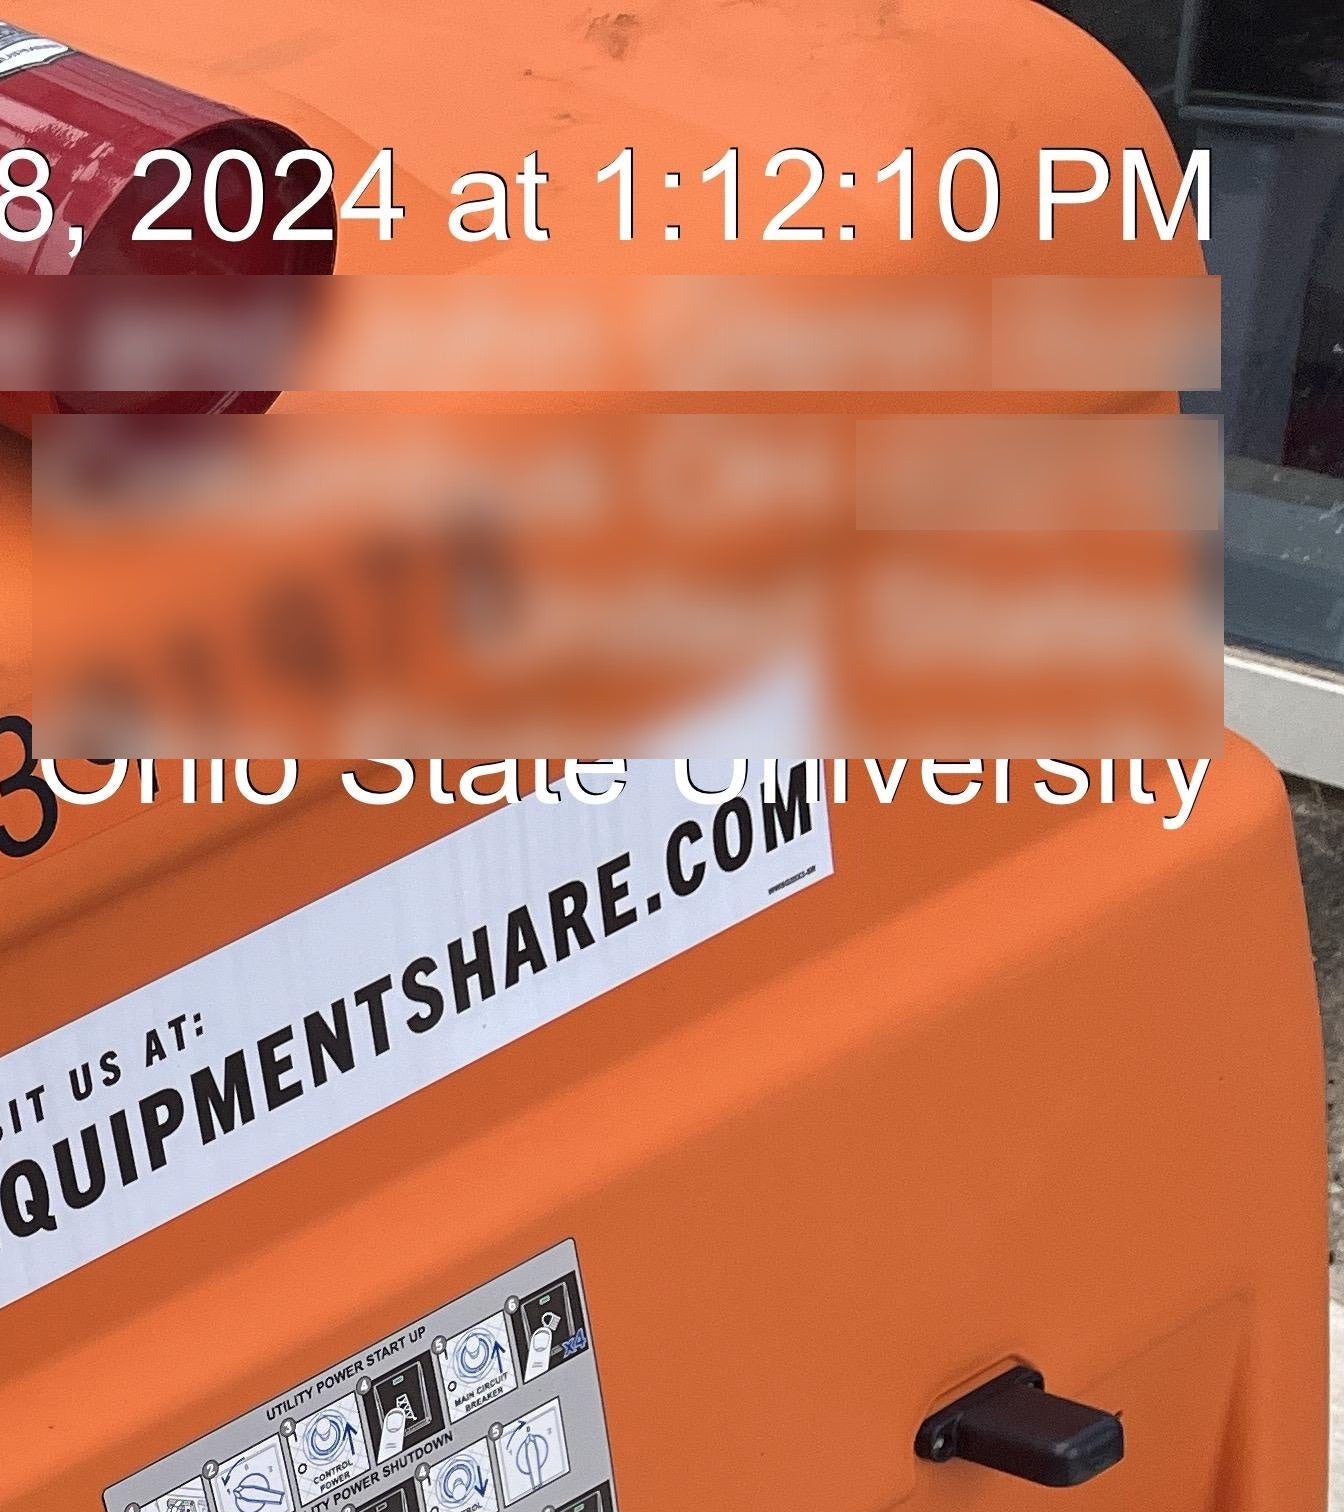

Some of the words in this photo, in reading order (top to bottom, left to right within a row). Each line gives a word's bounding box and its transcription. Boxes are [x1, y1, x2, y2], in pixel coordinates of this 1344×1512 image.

[68, 1050, 123, 1102] US
[145, 1011, 205, 1068] AT:
[506, 1296, 517, 1312] 6
[433, 1336, 443, 1352] 5
[560, 1326, 586, 1358] x4
[265, 1385, 314, 1423] UTILITY
[315, 1357, 364, 1395] POWER
[365, 1334, 407, 1368] START
[408, 1323, 427, 1345] UP
[358, 1377, 369, 1393] 4
[453, 1389, 475, 1408] MAIN
[475, 1370, 509, 1396] CIRCUIT
[464, 1384, 504, 1413] BREAKER
[283, 1419, 293, 1434] 3
[490, 1423, 500, 1439] 5
[204, 1462, 216, 1477] 2
[312, 1456, 354, 1486] CONTROL
[332, 1469, 381, 1506] POWER
[381, 1429, 453, 1479] SHUTDOWN
[416, 1463, 427, 1479] 4
[319, 1469, 351, 1494] POWER
